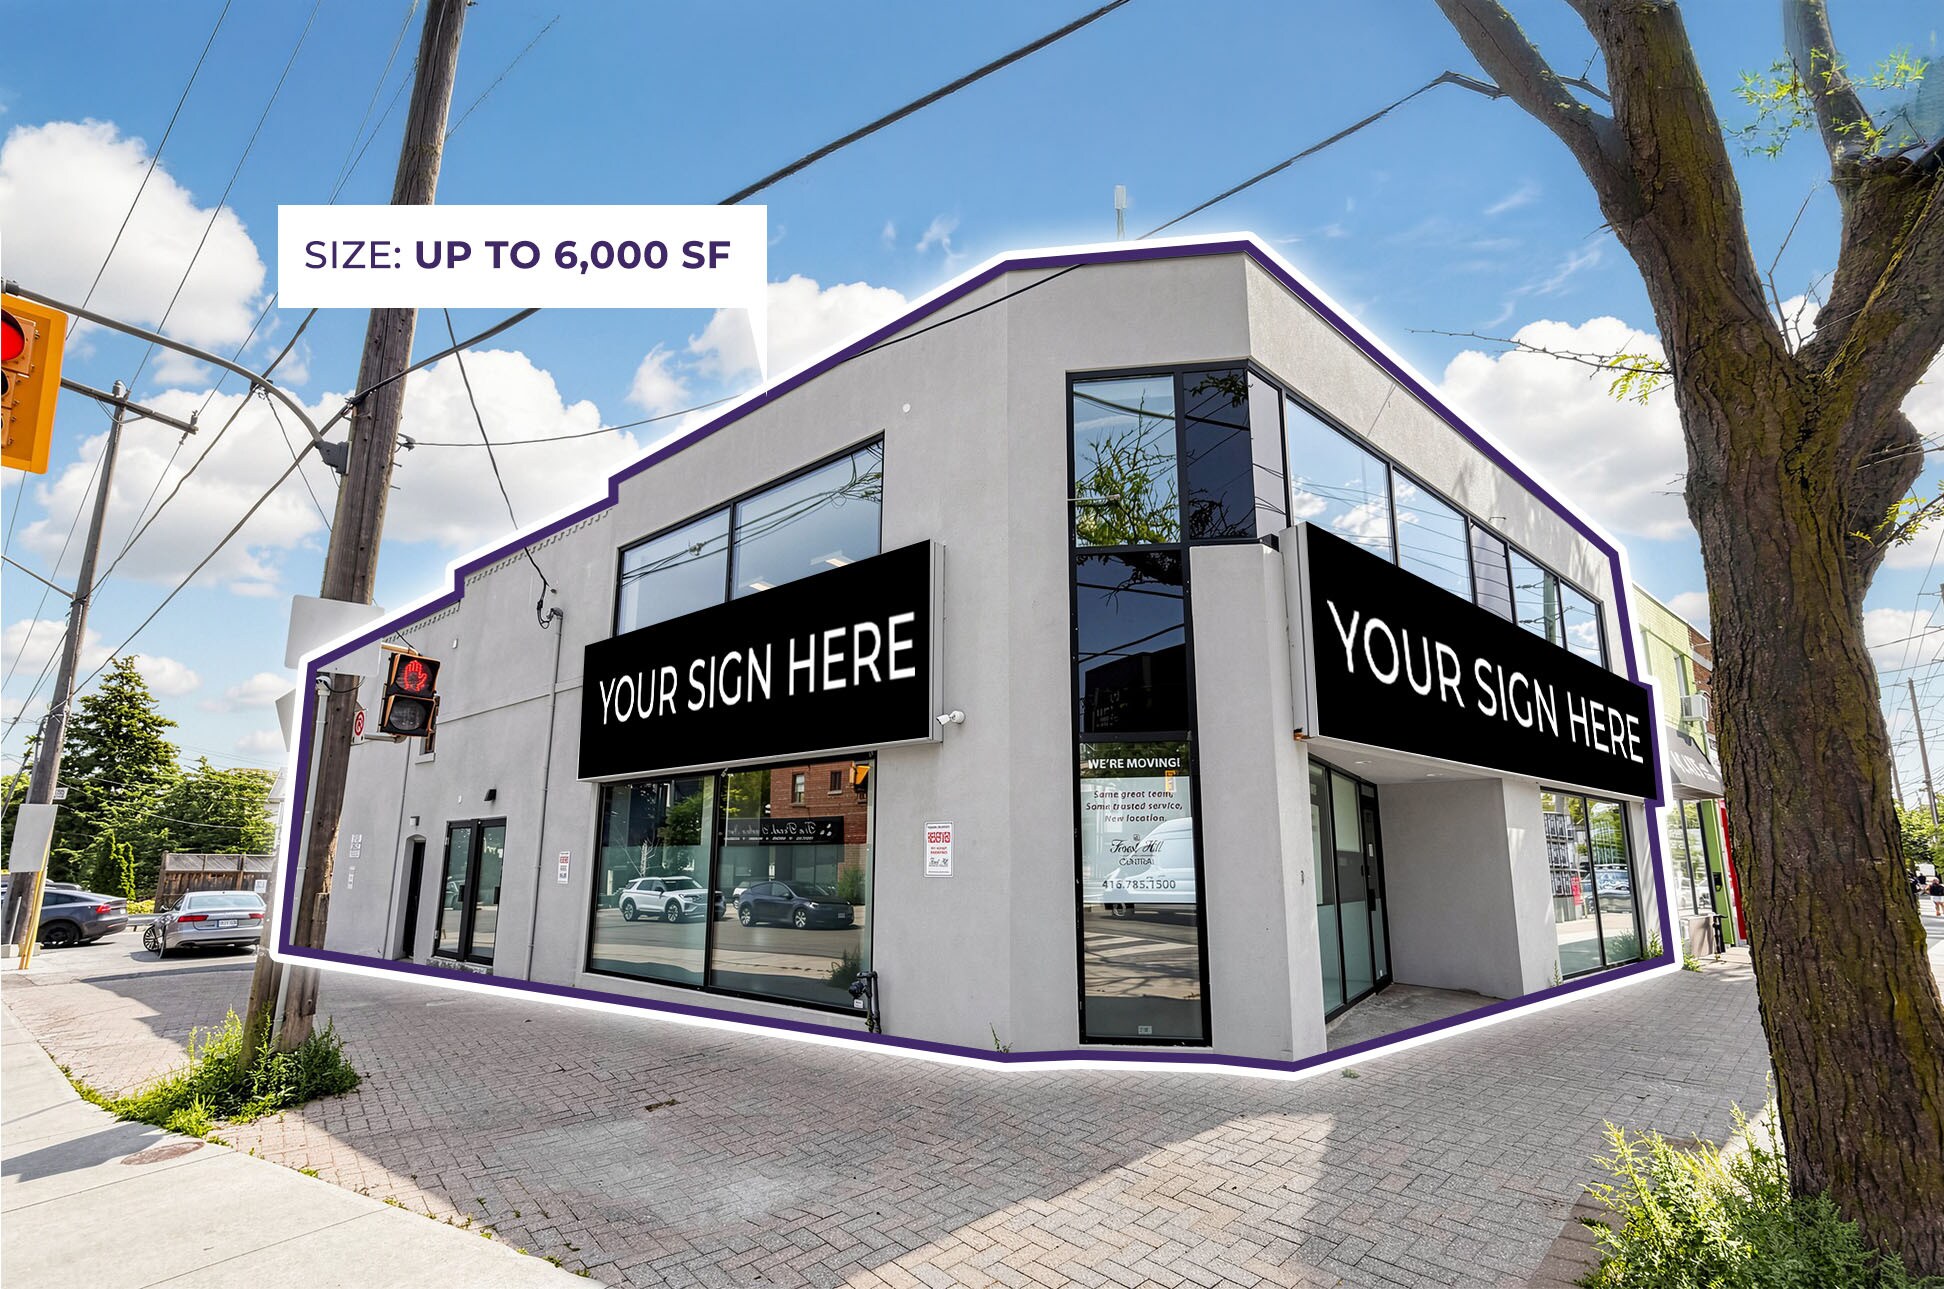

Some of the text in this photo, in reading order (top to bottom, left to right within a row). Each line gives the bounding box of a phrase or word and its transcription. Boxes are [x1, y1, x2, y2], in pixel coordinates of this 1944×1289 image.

[1088, 757, 1181, 769] WE'RE MOVING!
[1112, 802, 1146, 811] trusted
[1148, 802, 1183, 811] service,
[1104, 815, 1124, 823] New
